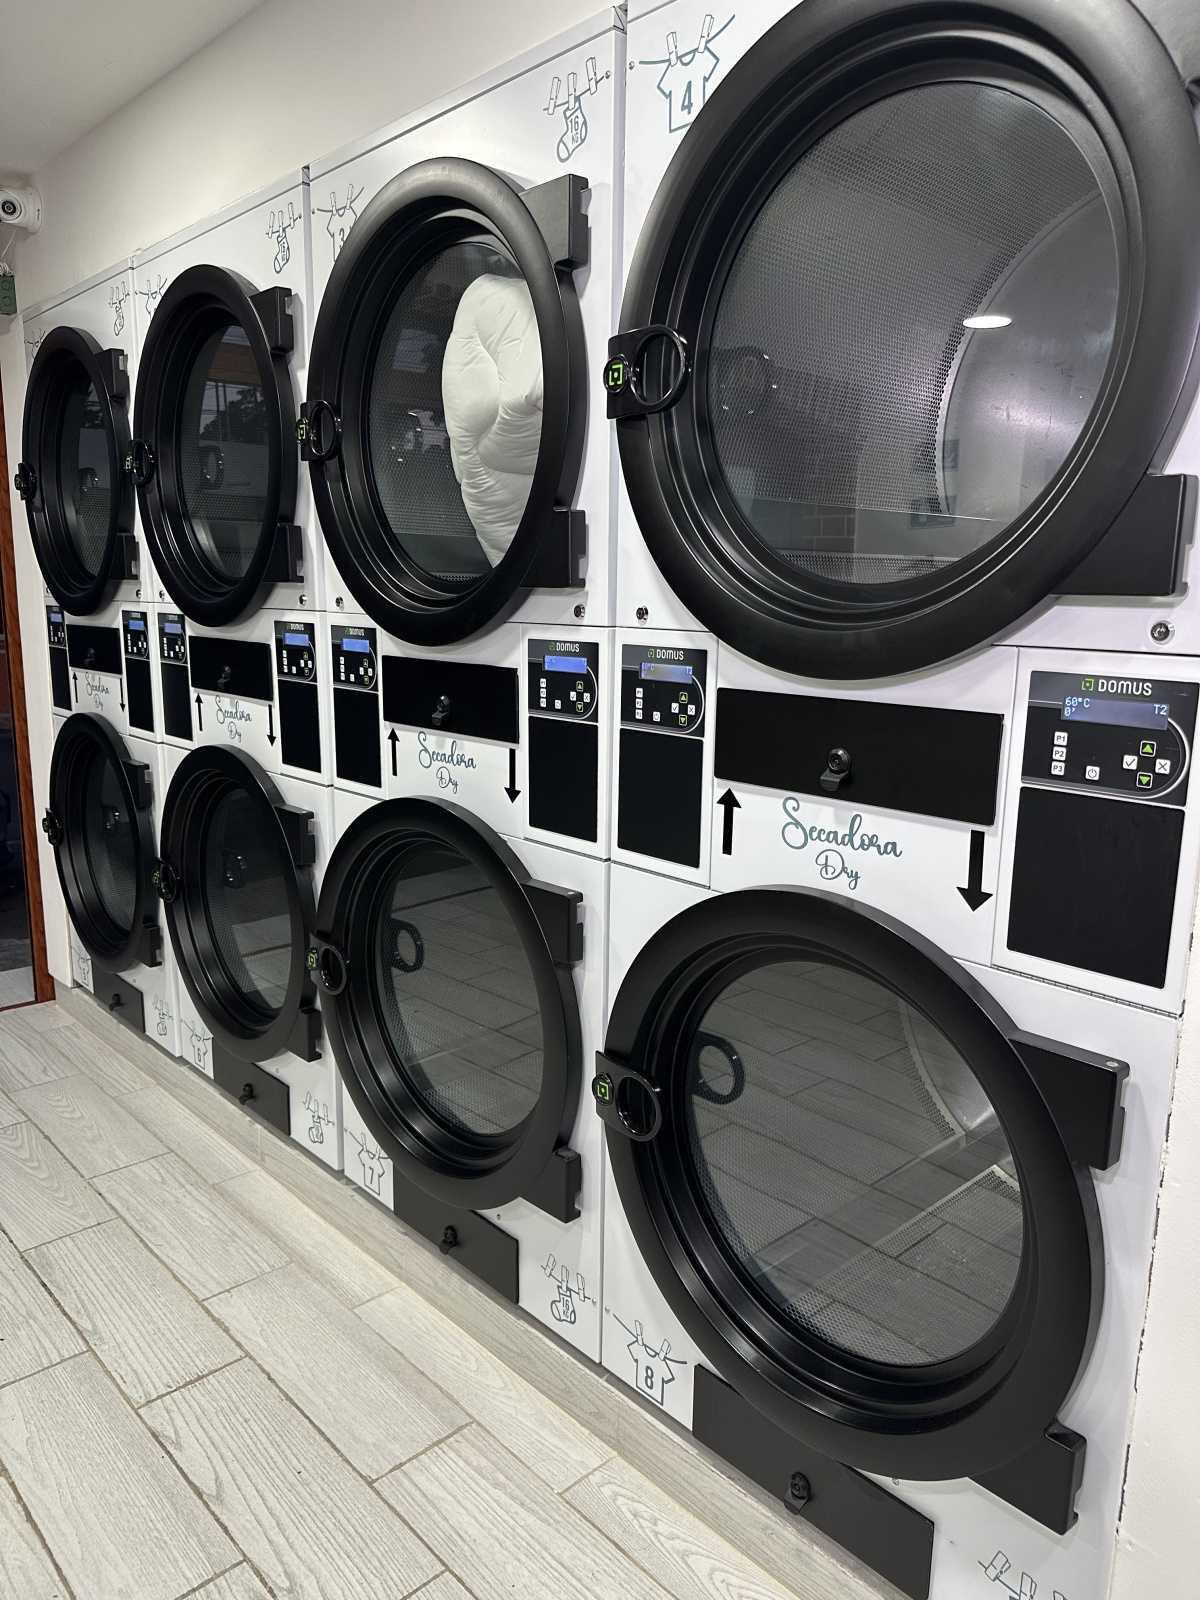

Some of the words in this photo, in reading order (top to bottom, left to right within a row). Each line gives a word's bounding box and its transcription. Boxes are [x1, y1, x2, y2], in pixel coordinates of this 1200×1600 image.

[681, 80, 693, 115] 4
[569, 115, 579, 133] 16
[556, 642, 580, 652] DOMUS
[656, 649, 684, 660] DOMUS
[1098, 679, 1153, 696] DOMUS
[1153, 704, 1168, 715] T2
[418, 731, 477, 769] Secadora
[436, 766, 459, 794] Dry
[782, 796, 903, 858] Secadora
[815, 848, 861, 890] Dry
[368, 1166, 375, 1185] 7
[644, 1365, 654, 1390] 8
